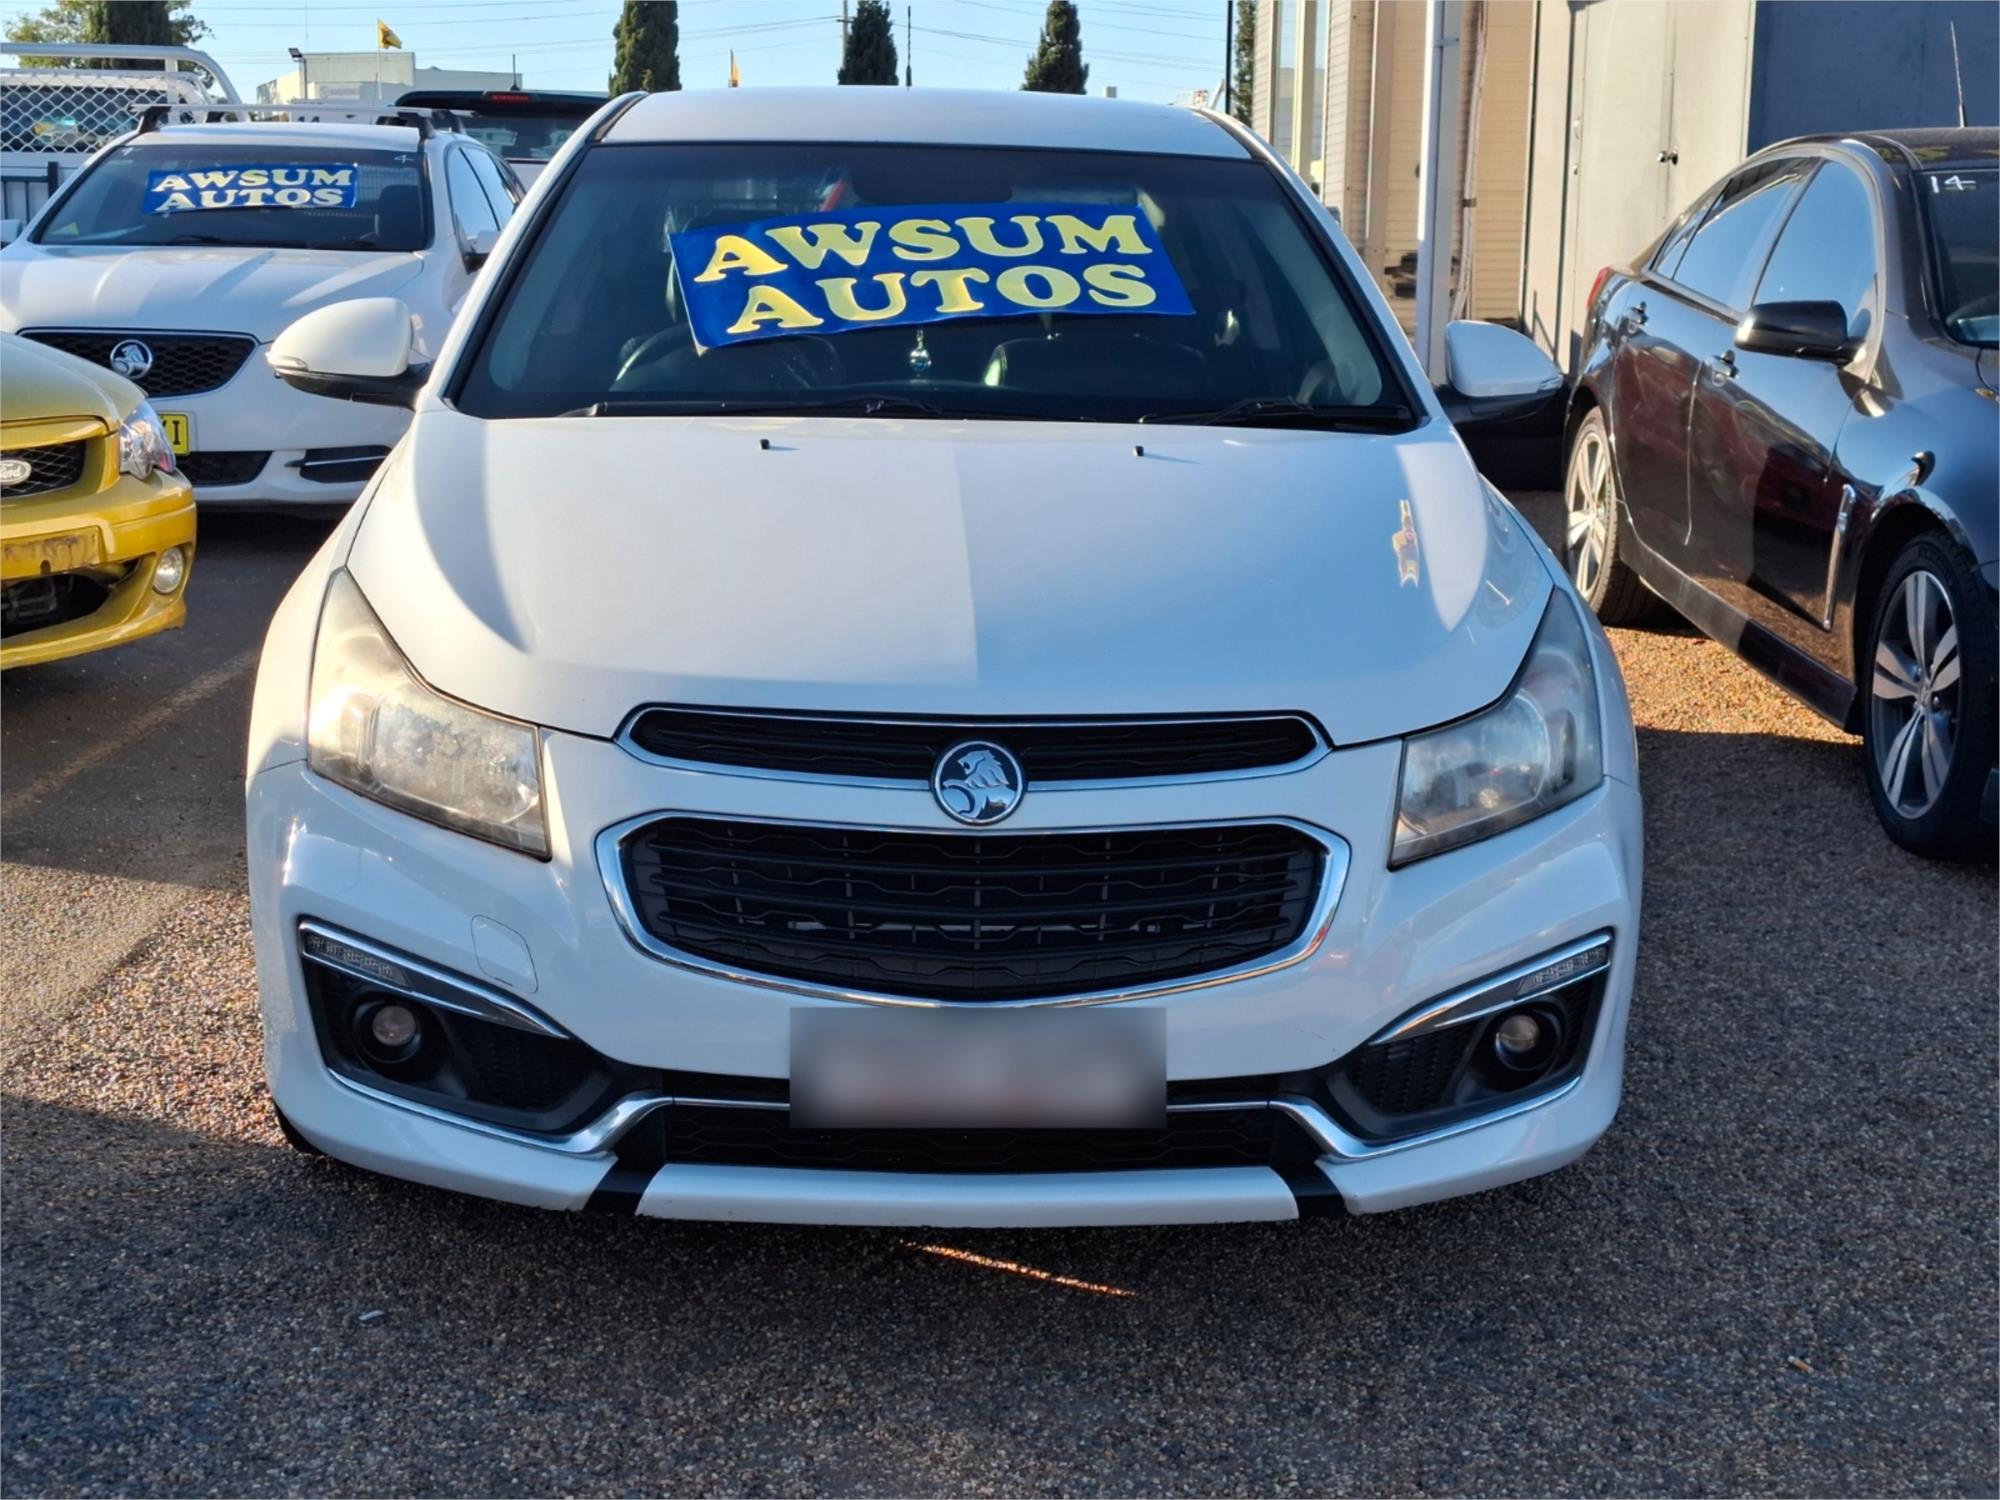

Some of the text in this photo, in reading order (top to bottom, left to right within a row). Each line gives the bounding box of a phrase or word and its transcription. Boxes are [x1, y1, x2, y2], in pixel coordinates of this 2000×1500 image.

[152, 169, 353, 192] AWSUM
[1930, 175, 1977, 193] 14
[155, 188, 343, 212] AUTOS
[694, 214, 1153, 283] AWSUM
[726, 263, 1157, 335] AUTOS
